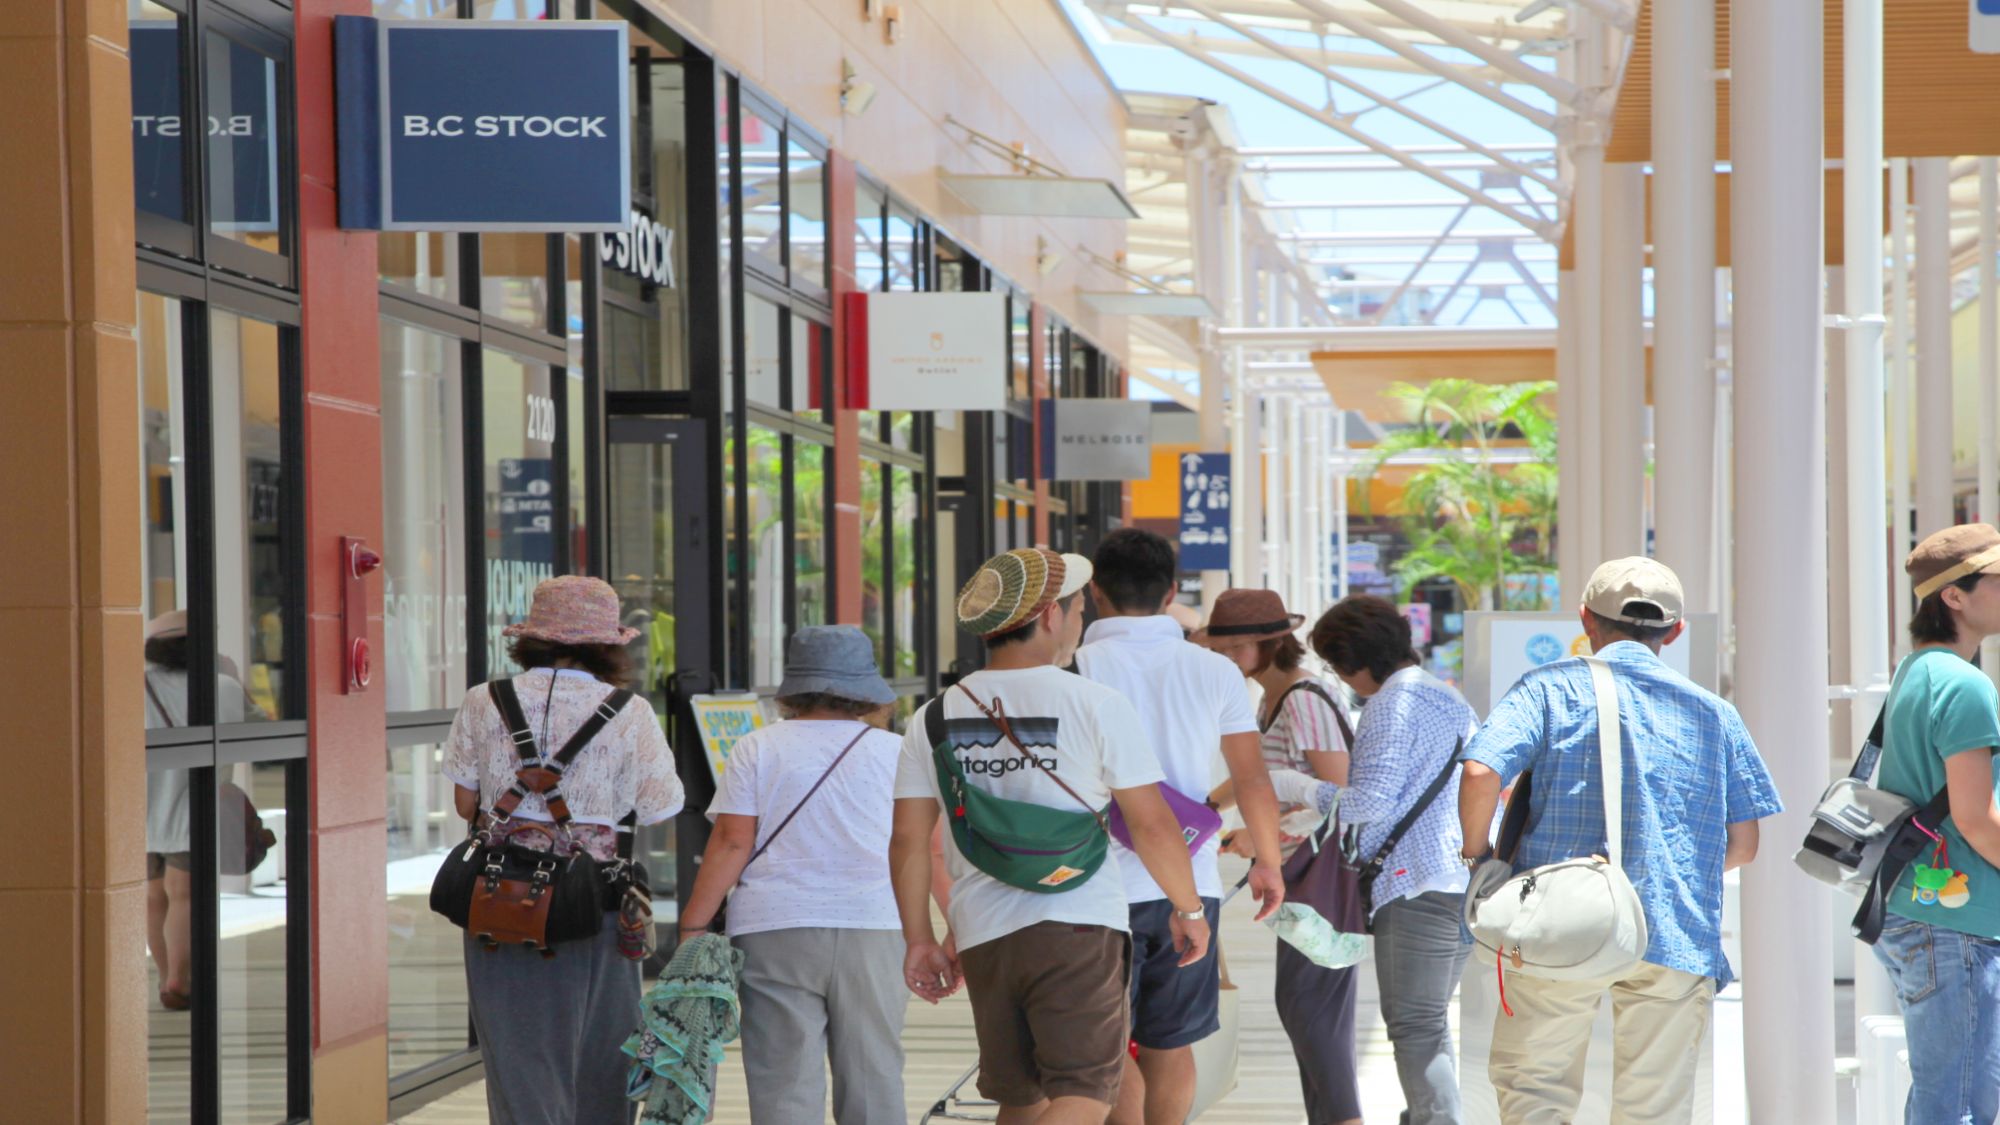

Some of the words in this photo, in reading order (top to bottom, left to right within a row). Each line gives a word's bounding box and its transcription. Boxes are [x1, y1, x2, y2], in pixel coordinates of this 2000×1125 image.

[404, 115, 463, 136] B.C
[474, 115, 607, 137] STOCK
[527, 394, 556, 443] 2120
[1061, 434, 1145, 444] MELROSE
[487, 559, 554, 616] JOURN
[957, 754, 1057, 778] tagonia
